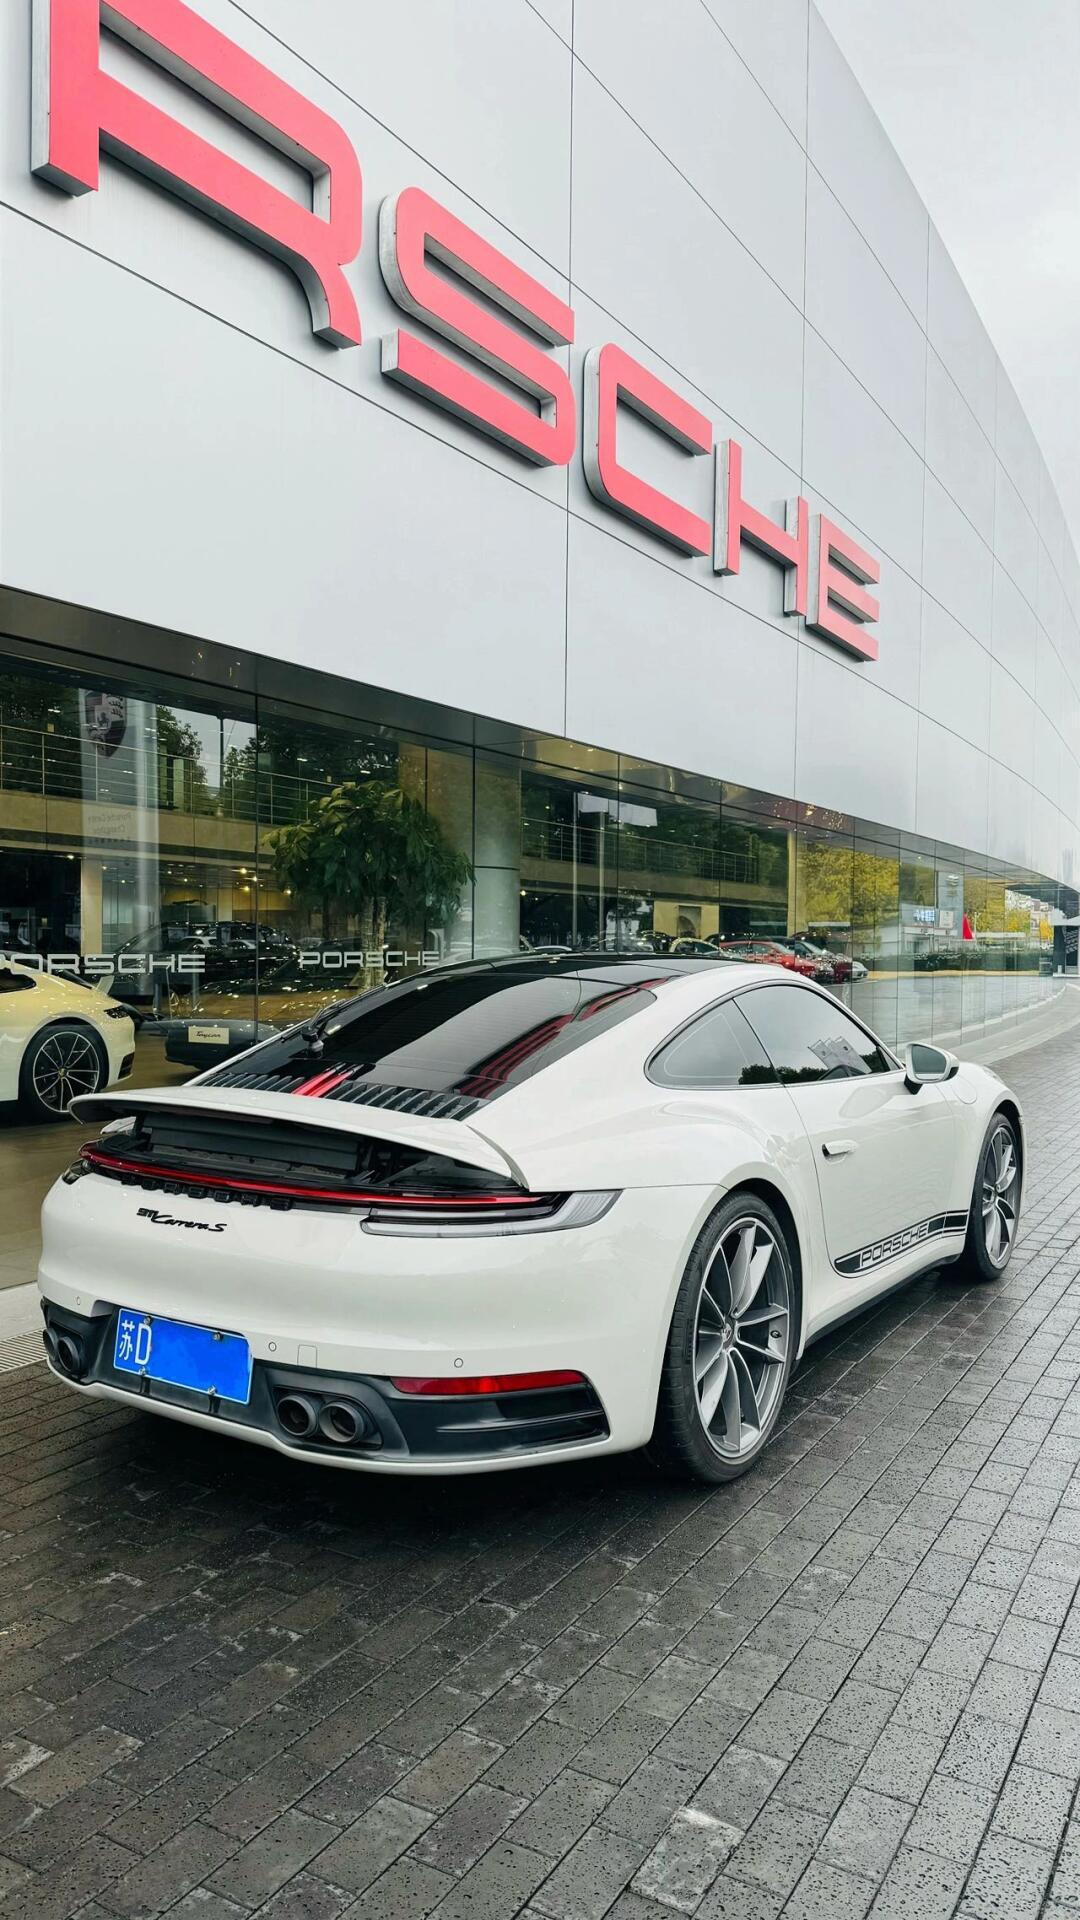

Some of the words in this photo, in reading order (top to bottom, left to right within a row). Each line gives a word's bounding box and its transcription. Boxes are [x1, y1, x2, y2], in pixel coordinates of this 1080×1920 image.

[299, 951, 440, 969] PORSCHE
[151, 1214, 210, 1230] Carrera
[208, 1223, 228, 1232] S
[861, 1222, 928, 1266] PORSCHE
